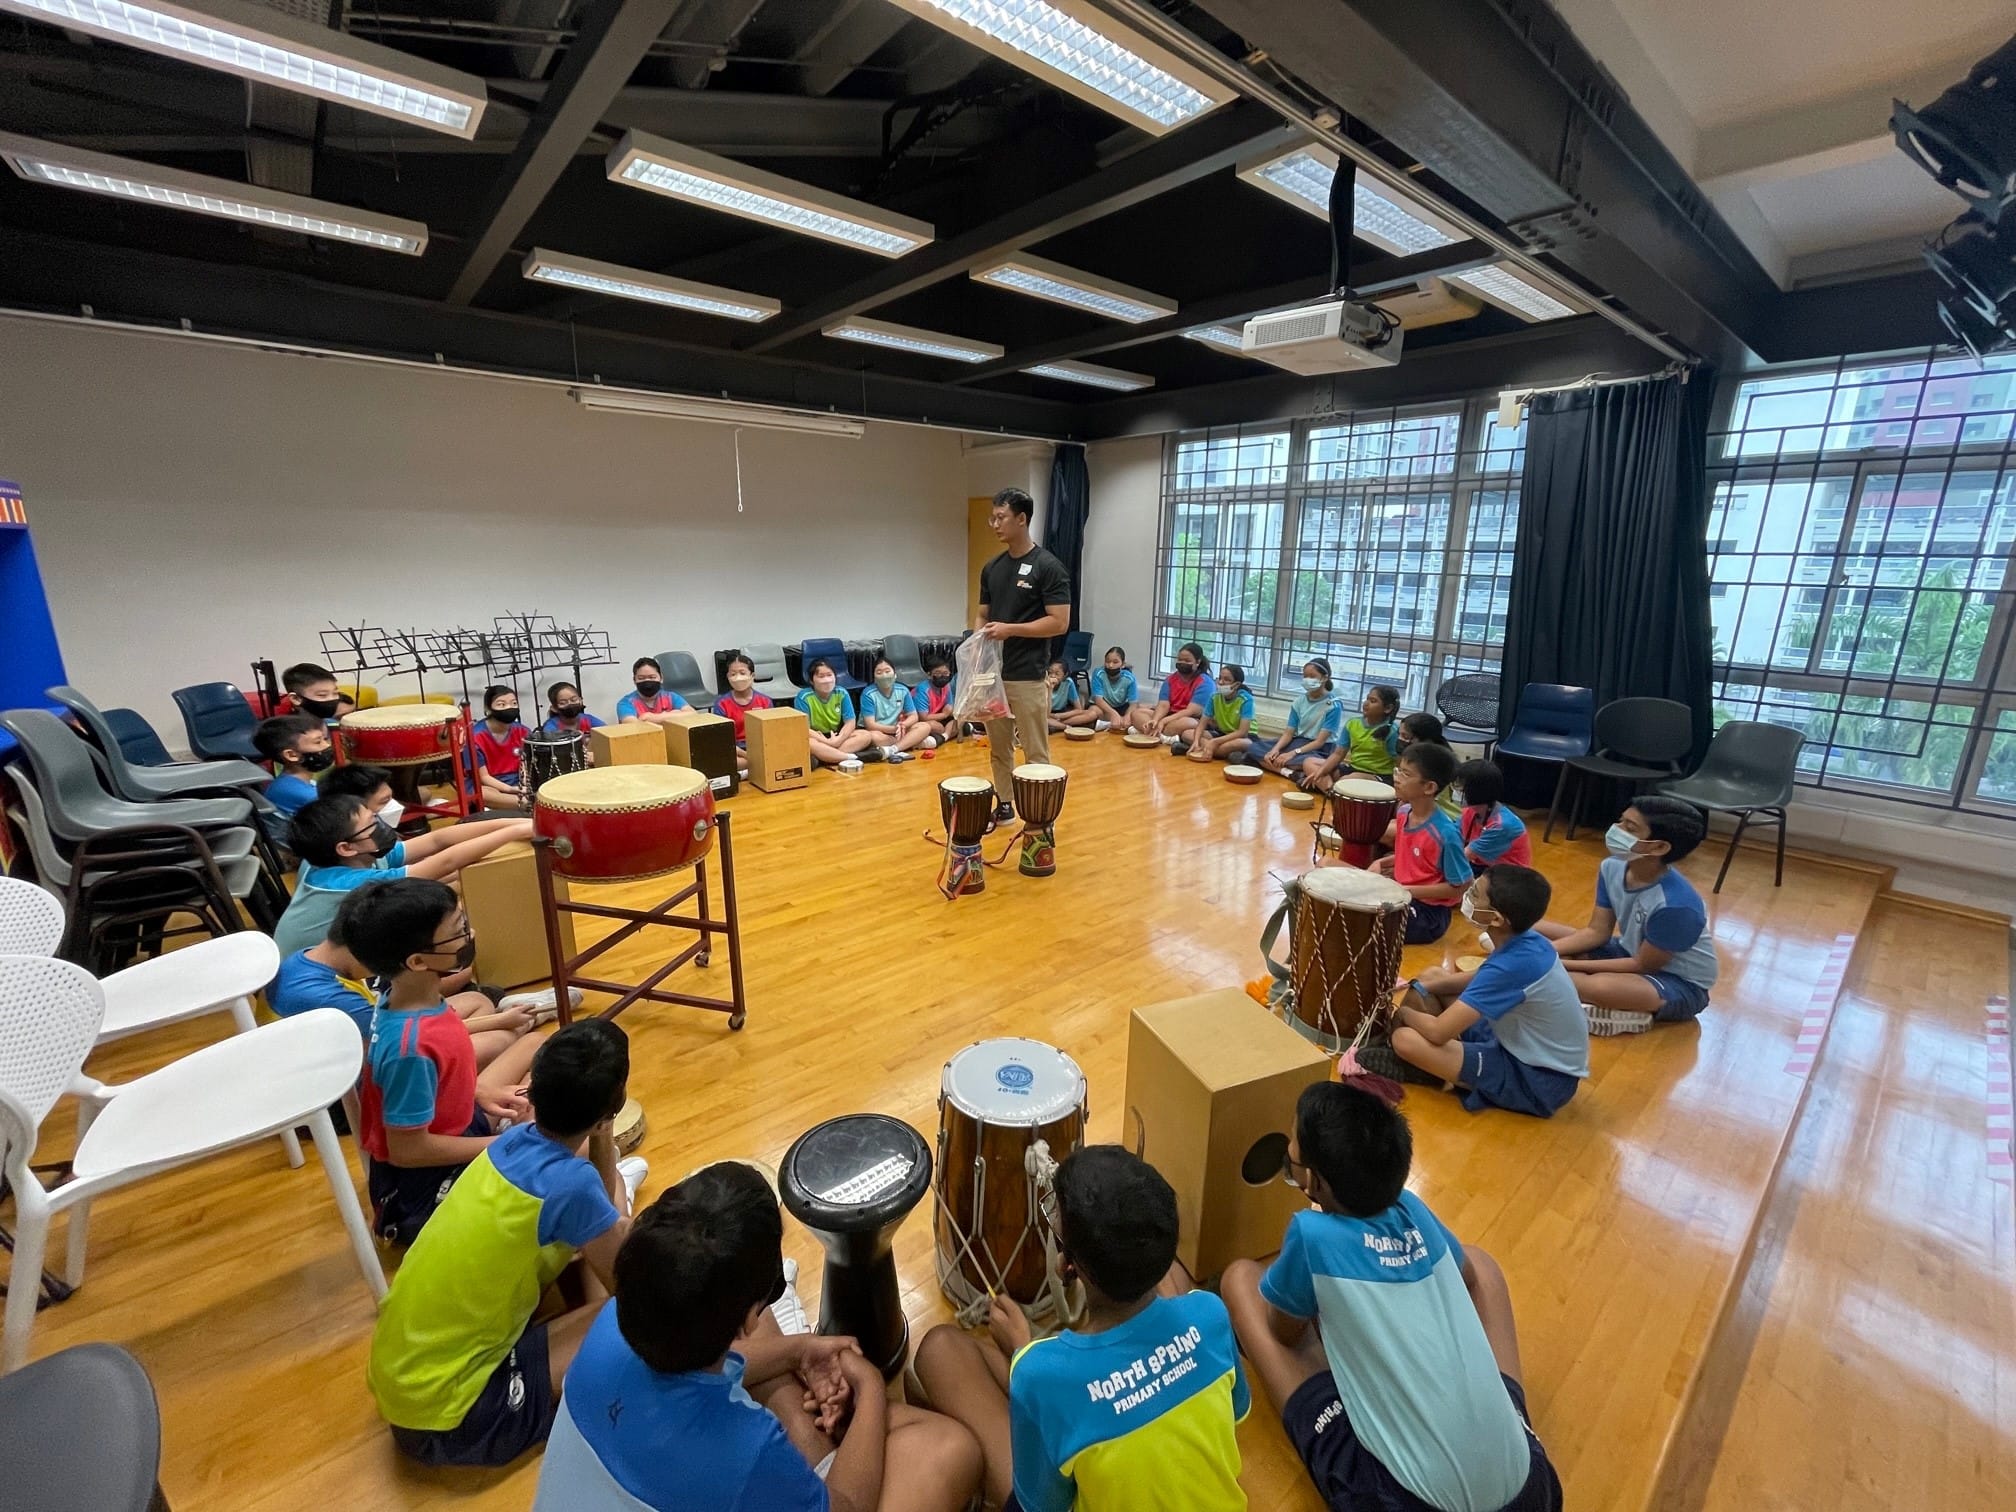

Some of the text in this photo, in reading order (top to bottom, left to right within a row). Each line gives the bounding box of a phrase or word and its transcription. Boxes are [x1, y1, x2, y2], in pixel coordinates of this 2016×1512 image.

[1087, 1358, 1148, 1401] NORTH
[1113, 1357, 1198, 1415] PRIMARY SCHOOL
